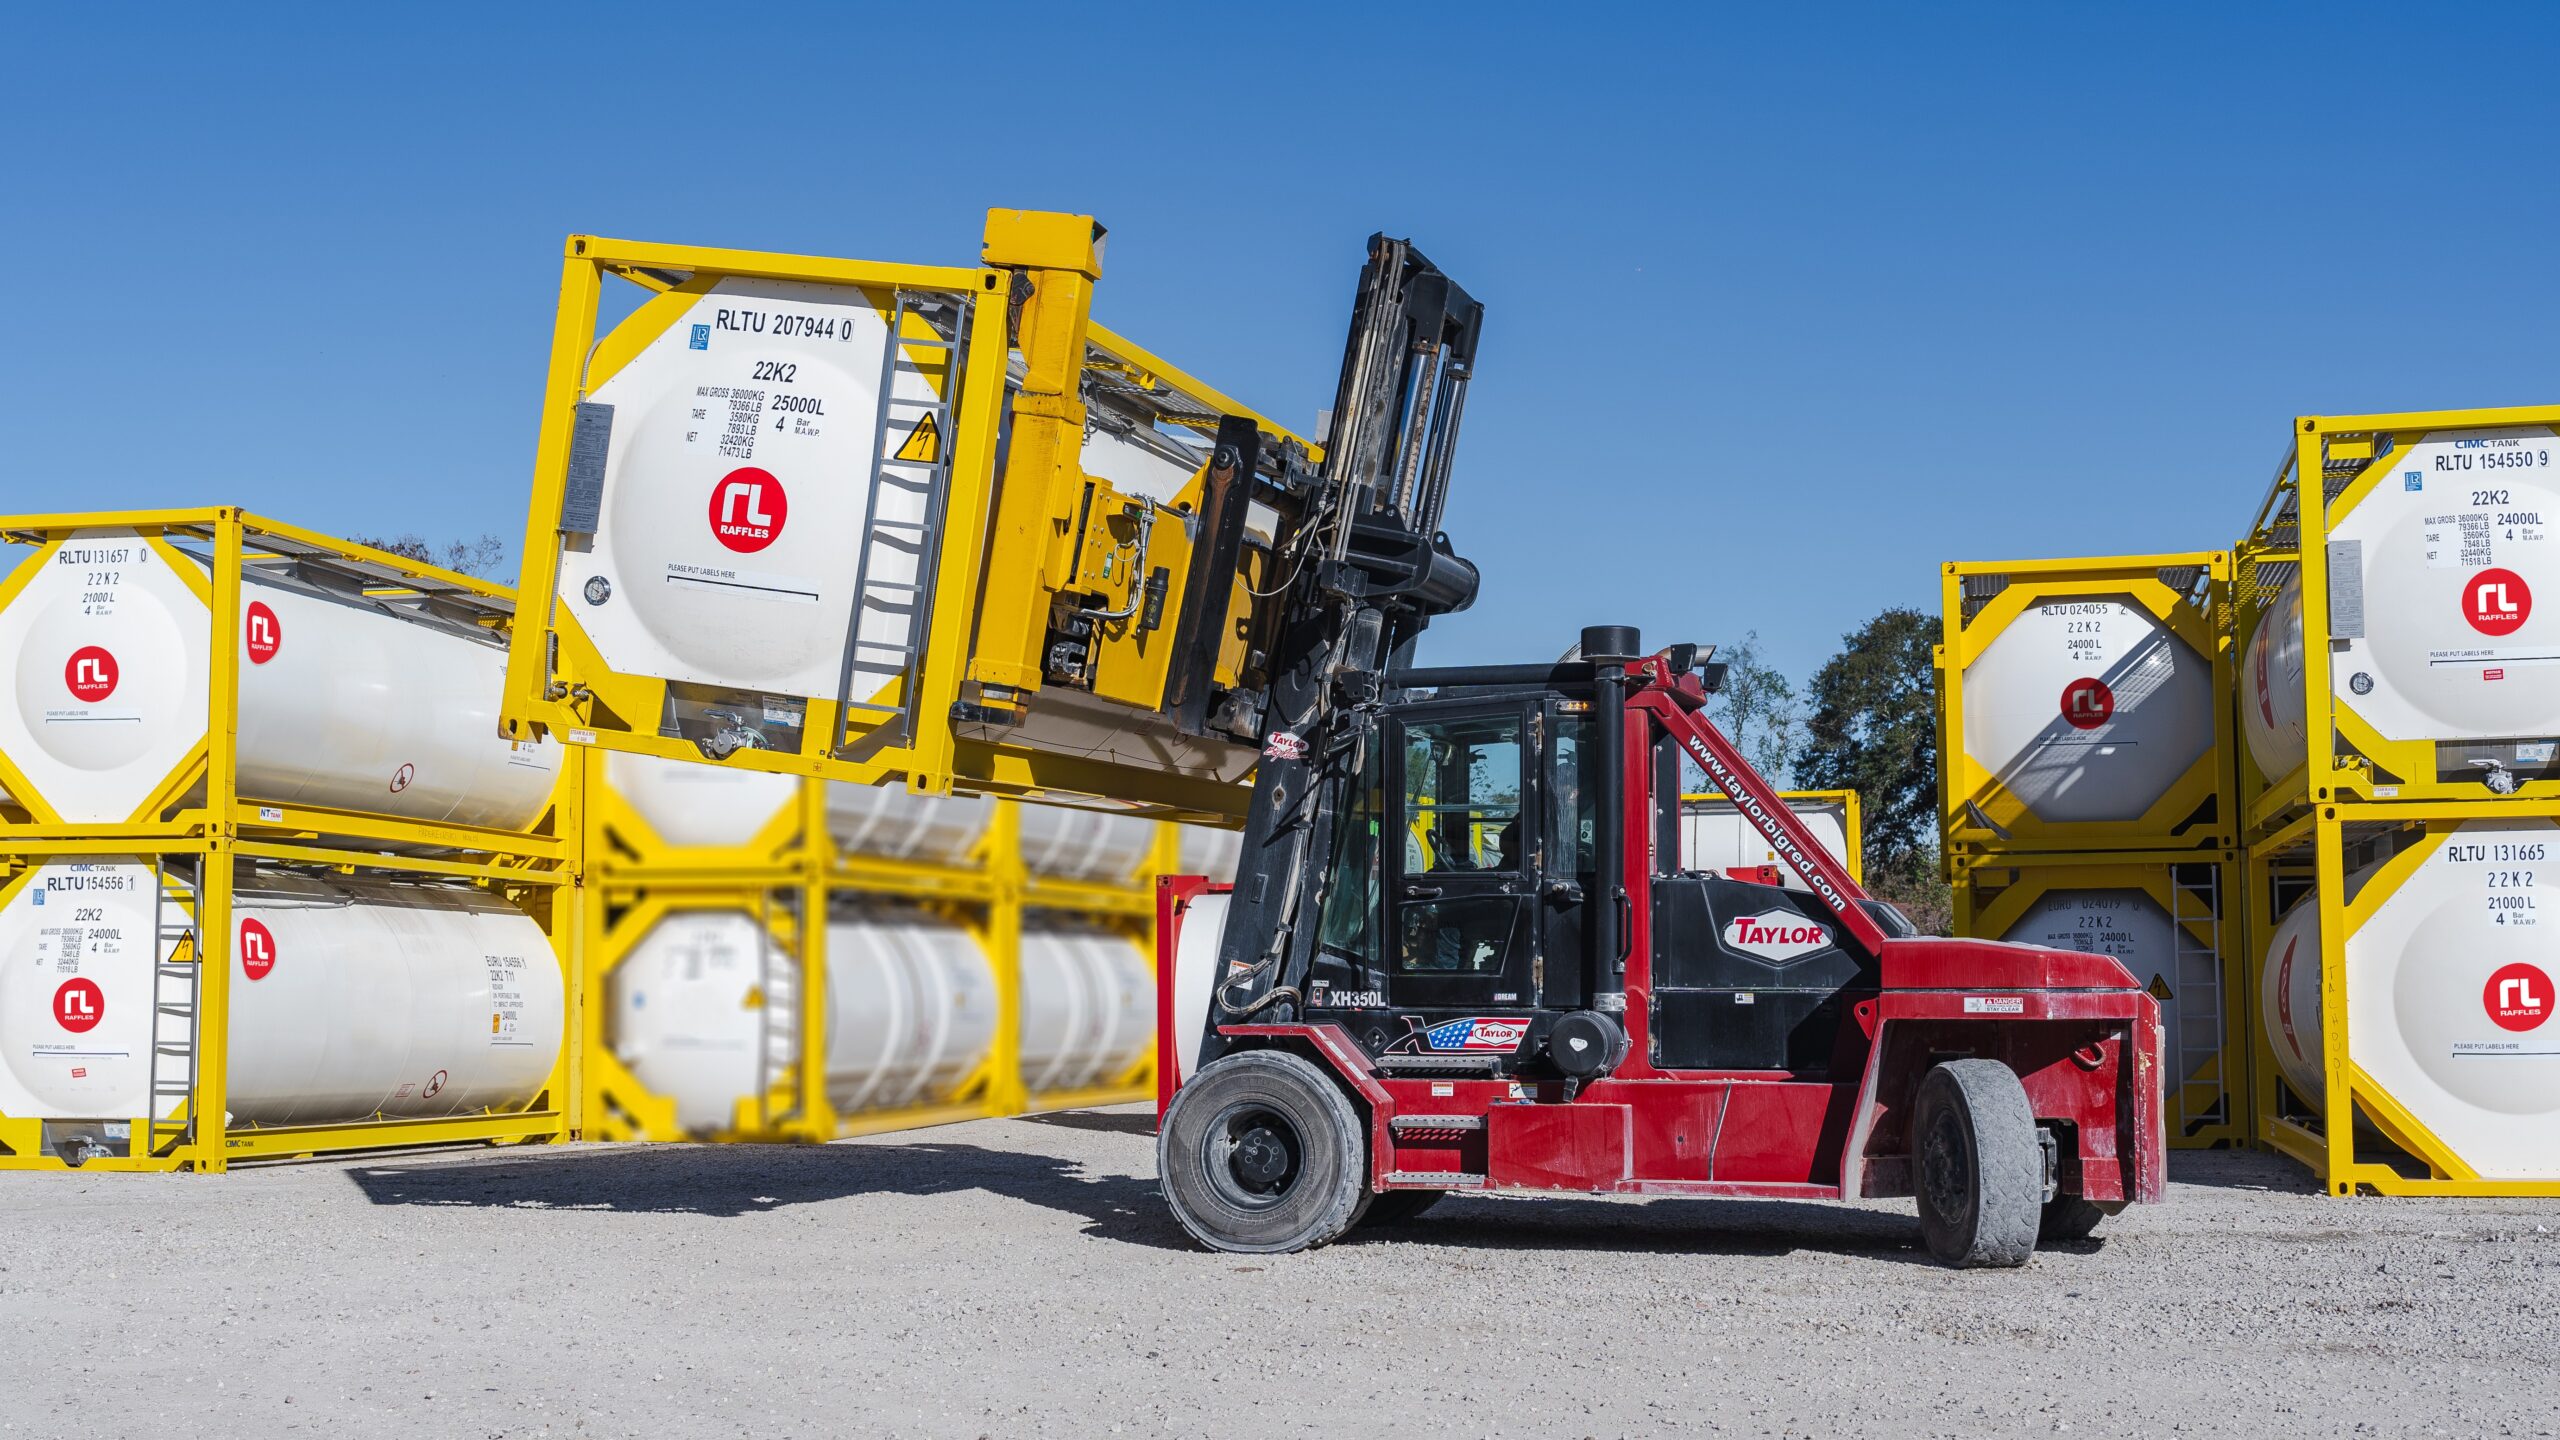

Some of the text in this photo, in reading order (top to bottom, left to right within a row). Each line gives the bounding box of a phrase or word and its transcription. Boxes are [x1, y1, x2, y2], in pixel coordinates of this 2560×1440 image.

[716, 309, 852, 340] RLTU 207944 0
[752, 361, 796, 383] 22K2
[696, 386, 765, 401] MAX GROSS 36000KG
[772, 394, 825, 416] 25000L
[692, 408, 759, 424] TARE 3580KG
[775, 416, 810, 432] 4 Bar
[686, 431, 754, 447] NET 32420KG
[2455, 439, 2489, 449] CIMC
[2436, 451, 2548, 471] RLTU 154550 9
[2472, 490, 2509, 506] 22K2
[2424, 513, 2489, 525] MAX GROSS 36000KG
[2497, 513, 2543, 525] 24000L
[720, 525, 769, 538] RAFFLES
[2426, 531, 2490, 542] TARE 3560KG
[2506, 529, 2513, 540] 4
[59, 549, 147, 564] RLTU 131657 0
[2427, 548, 2491, 560] NET 32440KG
[668, 563, 736, 579] PLEASE PUT LABELS HERE
[83, 593, 115, 603] 21000 L
[84, 606, 91, 615] 4
[2041, 605, 2067, 616] RLTU
[2070, 604, 2108, 615] 024055
[2478, 613, 2518, 621] RAFFLES
[251, 643, 272, 651] RAFFLES
[2068, 640, 2101, 649] 24000 L
[2073, 651, 2079, 660] 4
[1273, 733, 1305, 749] TAYLOR
[1689, 735, 1846, 912] www.taylorbigred.com
[2449, 844, 2545, 862] RLTU 131665
[70, 864, 94, 872] CIMC
[47, 877, 84, 891] RLTU
[86, 877, 123, 890] 154556
[2488, 896, 2535, 909] 21000 L
[75, 908, 103, 921] 22K2
[2496, 913, 2505, 925] 4
[88, 929, 122, 940] 24000L
[1735, 919, 1822, 944] TAYLOR
[2100, 932, 2134, 942] 24000 L
[91, 943, 97, 953] 4
[2105, 945, 2111, 953] 4
[1330, 991, 1386, 1007] XH350L
[1480, 1027, 1512, 1037] TAYLOR
